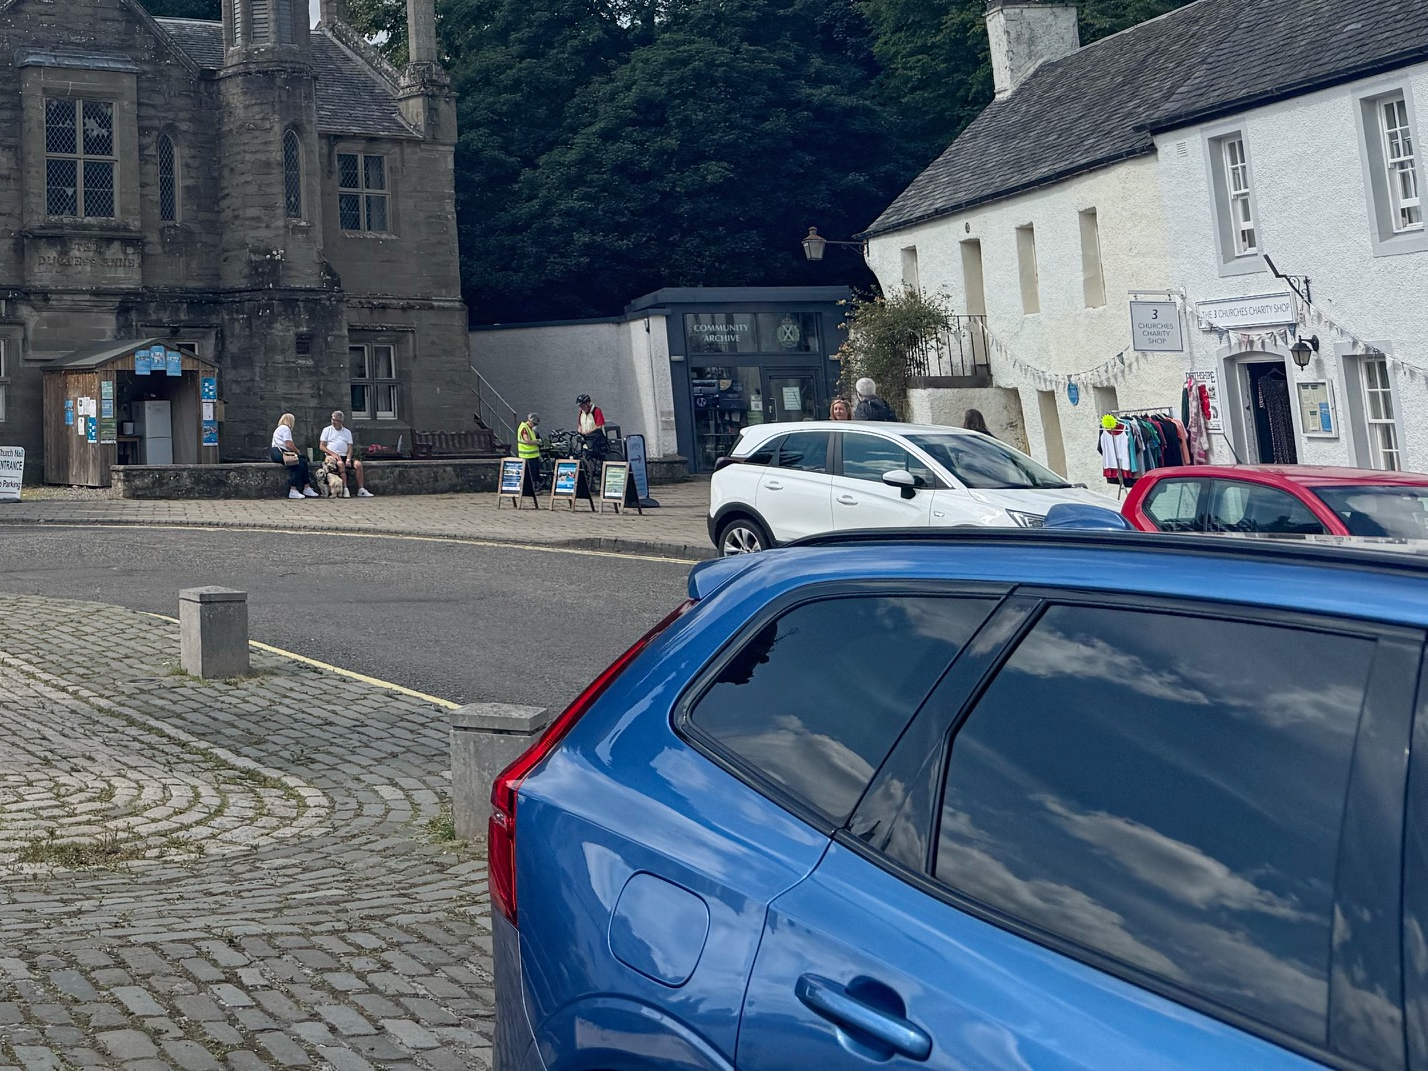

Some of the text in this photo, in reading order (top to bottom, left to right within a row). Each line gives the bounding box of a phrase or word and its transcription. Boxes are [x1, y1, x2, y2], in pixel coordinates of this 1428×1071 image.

[1151, 309, 1158, 320] 3
[1201, 302, 1290, 319] THE 3 CHURCHES CHARITY SHOP
[693, 324, 749, 332] COMMUNITY
[1137, 322, 1174, 330] CHURCHES
[703, 334, 741, 342] ARCHIVE
[1147, 337, 1167, 345] SHOP
[14, 449, 24, 458] Hall
[2, 479, 21, 491] Parking
